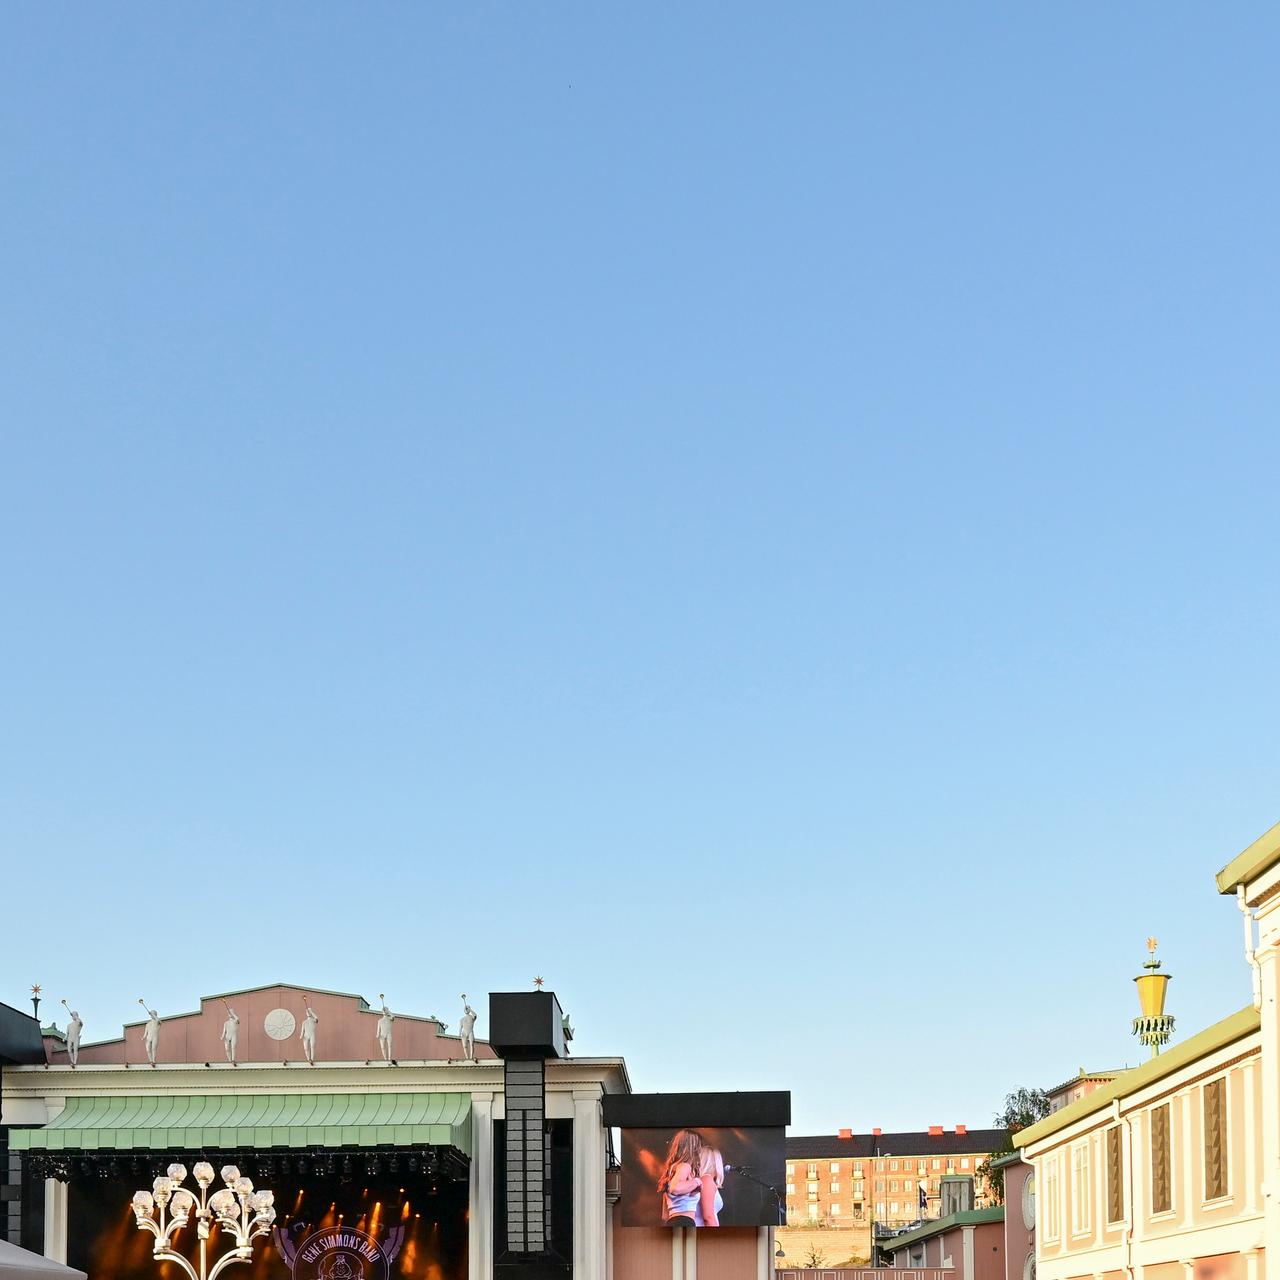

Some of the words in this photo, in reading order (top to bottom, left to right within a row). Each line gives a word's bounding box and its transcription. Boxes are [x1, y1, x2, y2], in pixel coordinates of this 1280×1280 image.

[302, 1240, 324, 1264] GENE
[320, 1234, 361, 1252] SIMMONS
[358, 1240, 381, 1264] BAND
